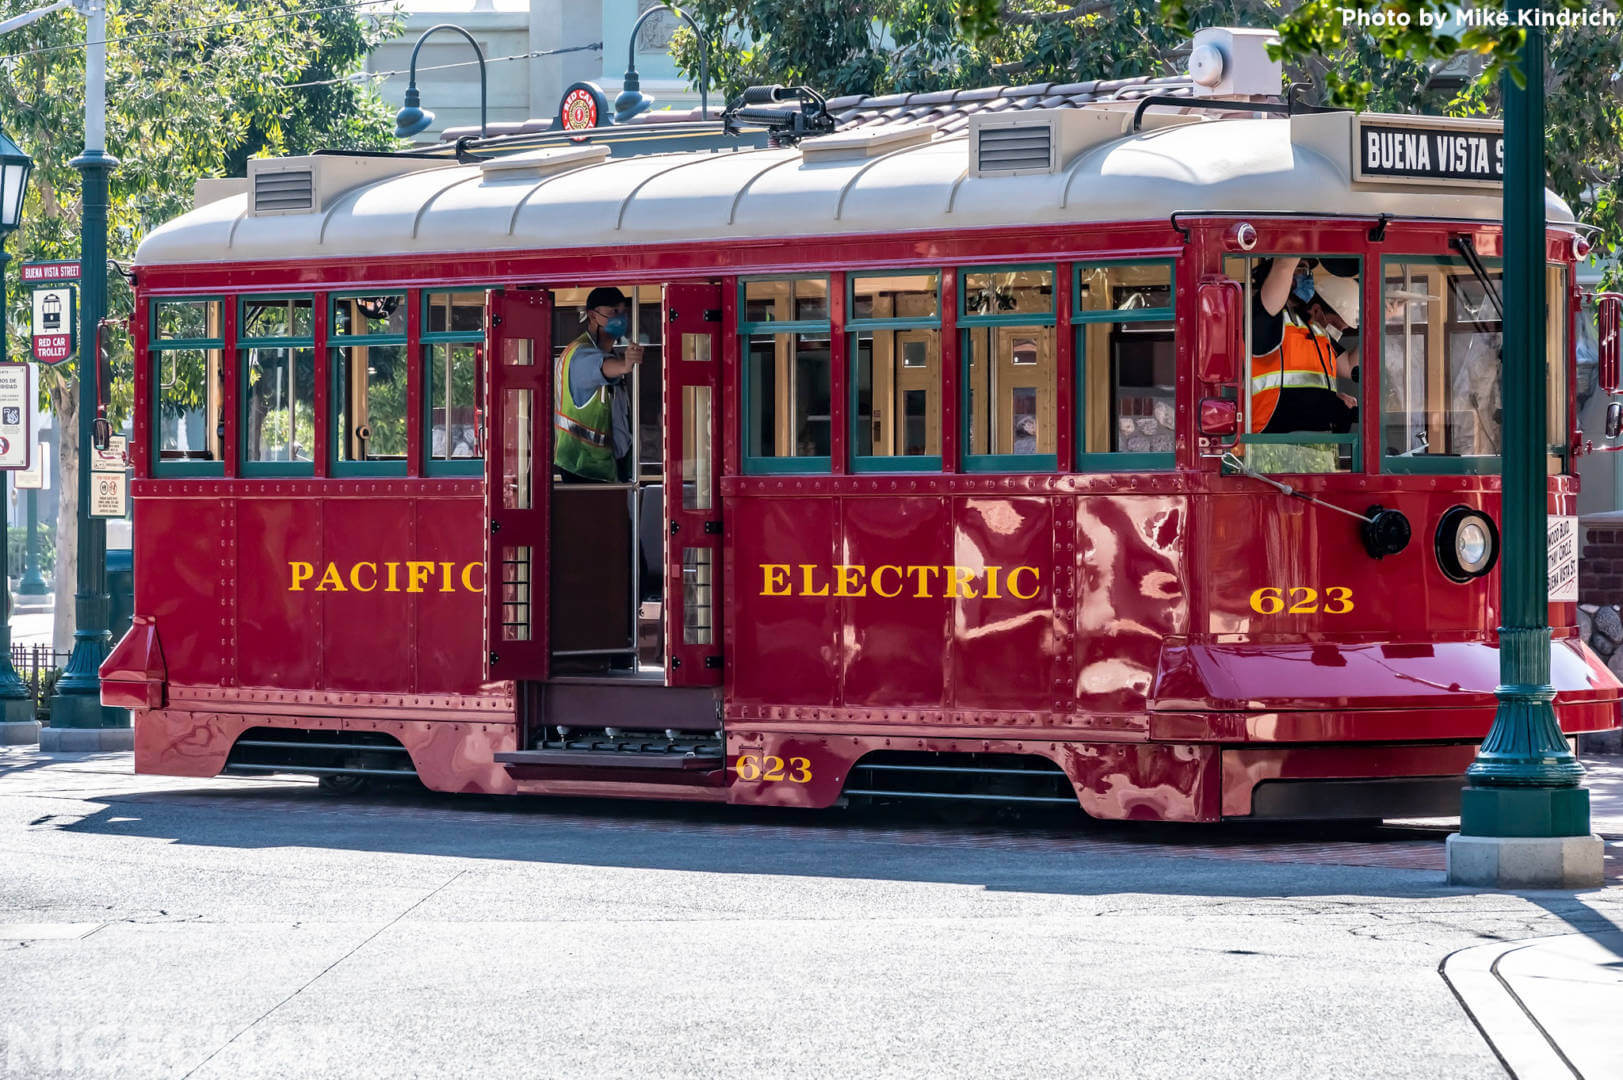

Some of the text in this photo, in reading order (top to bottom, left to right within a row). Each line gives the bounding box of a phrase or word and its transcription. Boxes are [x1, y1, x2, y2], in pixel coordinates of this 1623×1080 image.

[564, 90, 594, 111] RED CAR
[1367, 131, 1504, 174] BUENA VISTA S
[25, 265, 79, 279] BUENA VISTA STREET
[38, 337, 66, 347] RED CAR
[38, 347, 66, 357] TROLLEY
[288, 561, 1040, 600] PACIFIC ELECTRIC
[1249, 586, 1355, 615] 623
[735, 754, 813, 784] 623
